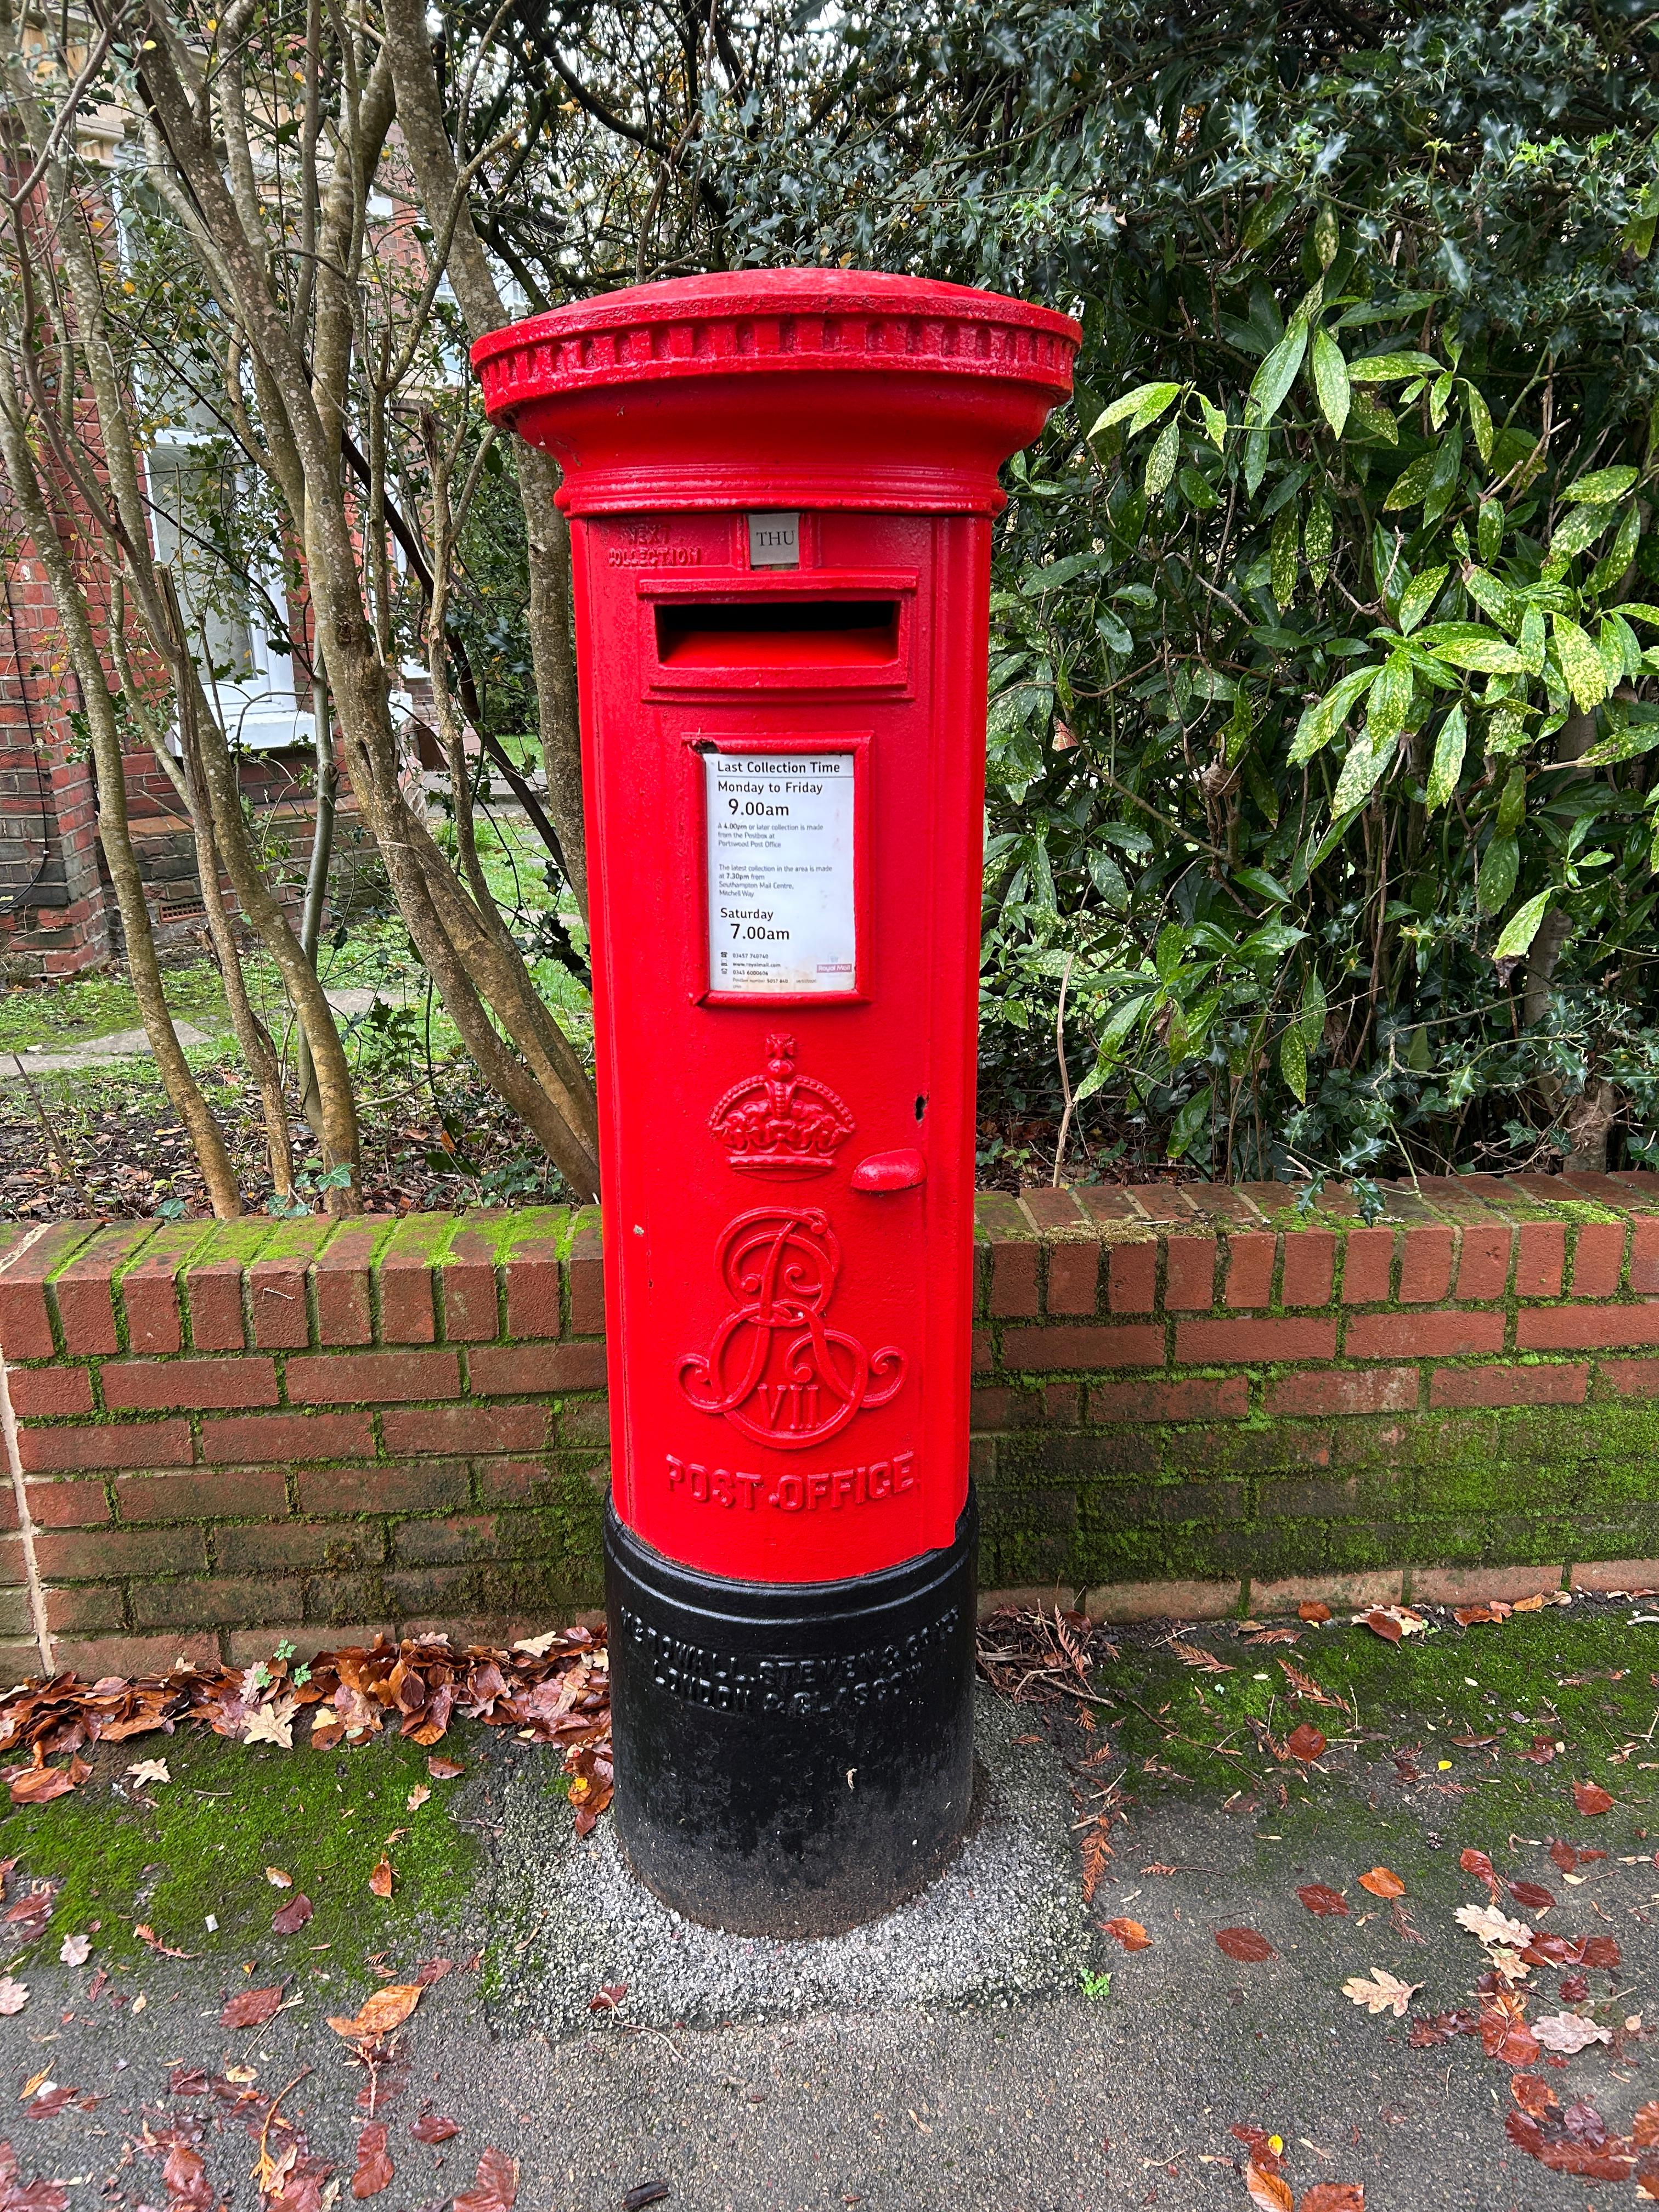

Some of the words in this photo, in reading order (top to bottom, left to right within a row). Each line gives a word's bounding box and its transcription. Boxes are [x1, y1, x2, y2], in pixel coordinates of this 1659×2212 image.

[756, 531, 794, 546] THU
[718, 761, 743, 772] Last
[747, 761, 806, 773] Collection
[810, 762, 840, 773] Time
[718, 782, 764, 794] Monday
[769, 782, 780, 793] to
[786, 782, 822, 794] Friday
[728, 799, 789, 816] 9.00am
[721, 908, 773, 921] Saturday
[730, 924, 789, 940] 7.00am
[666, 1453, 763, 1509] POST
[778, 1449, 915, 1512] OFFICE
